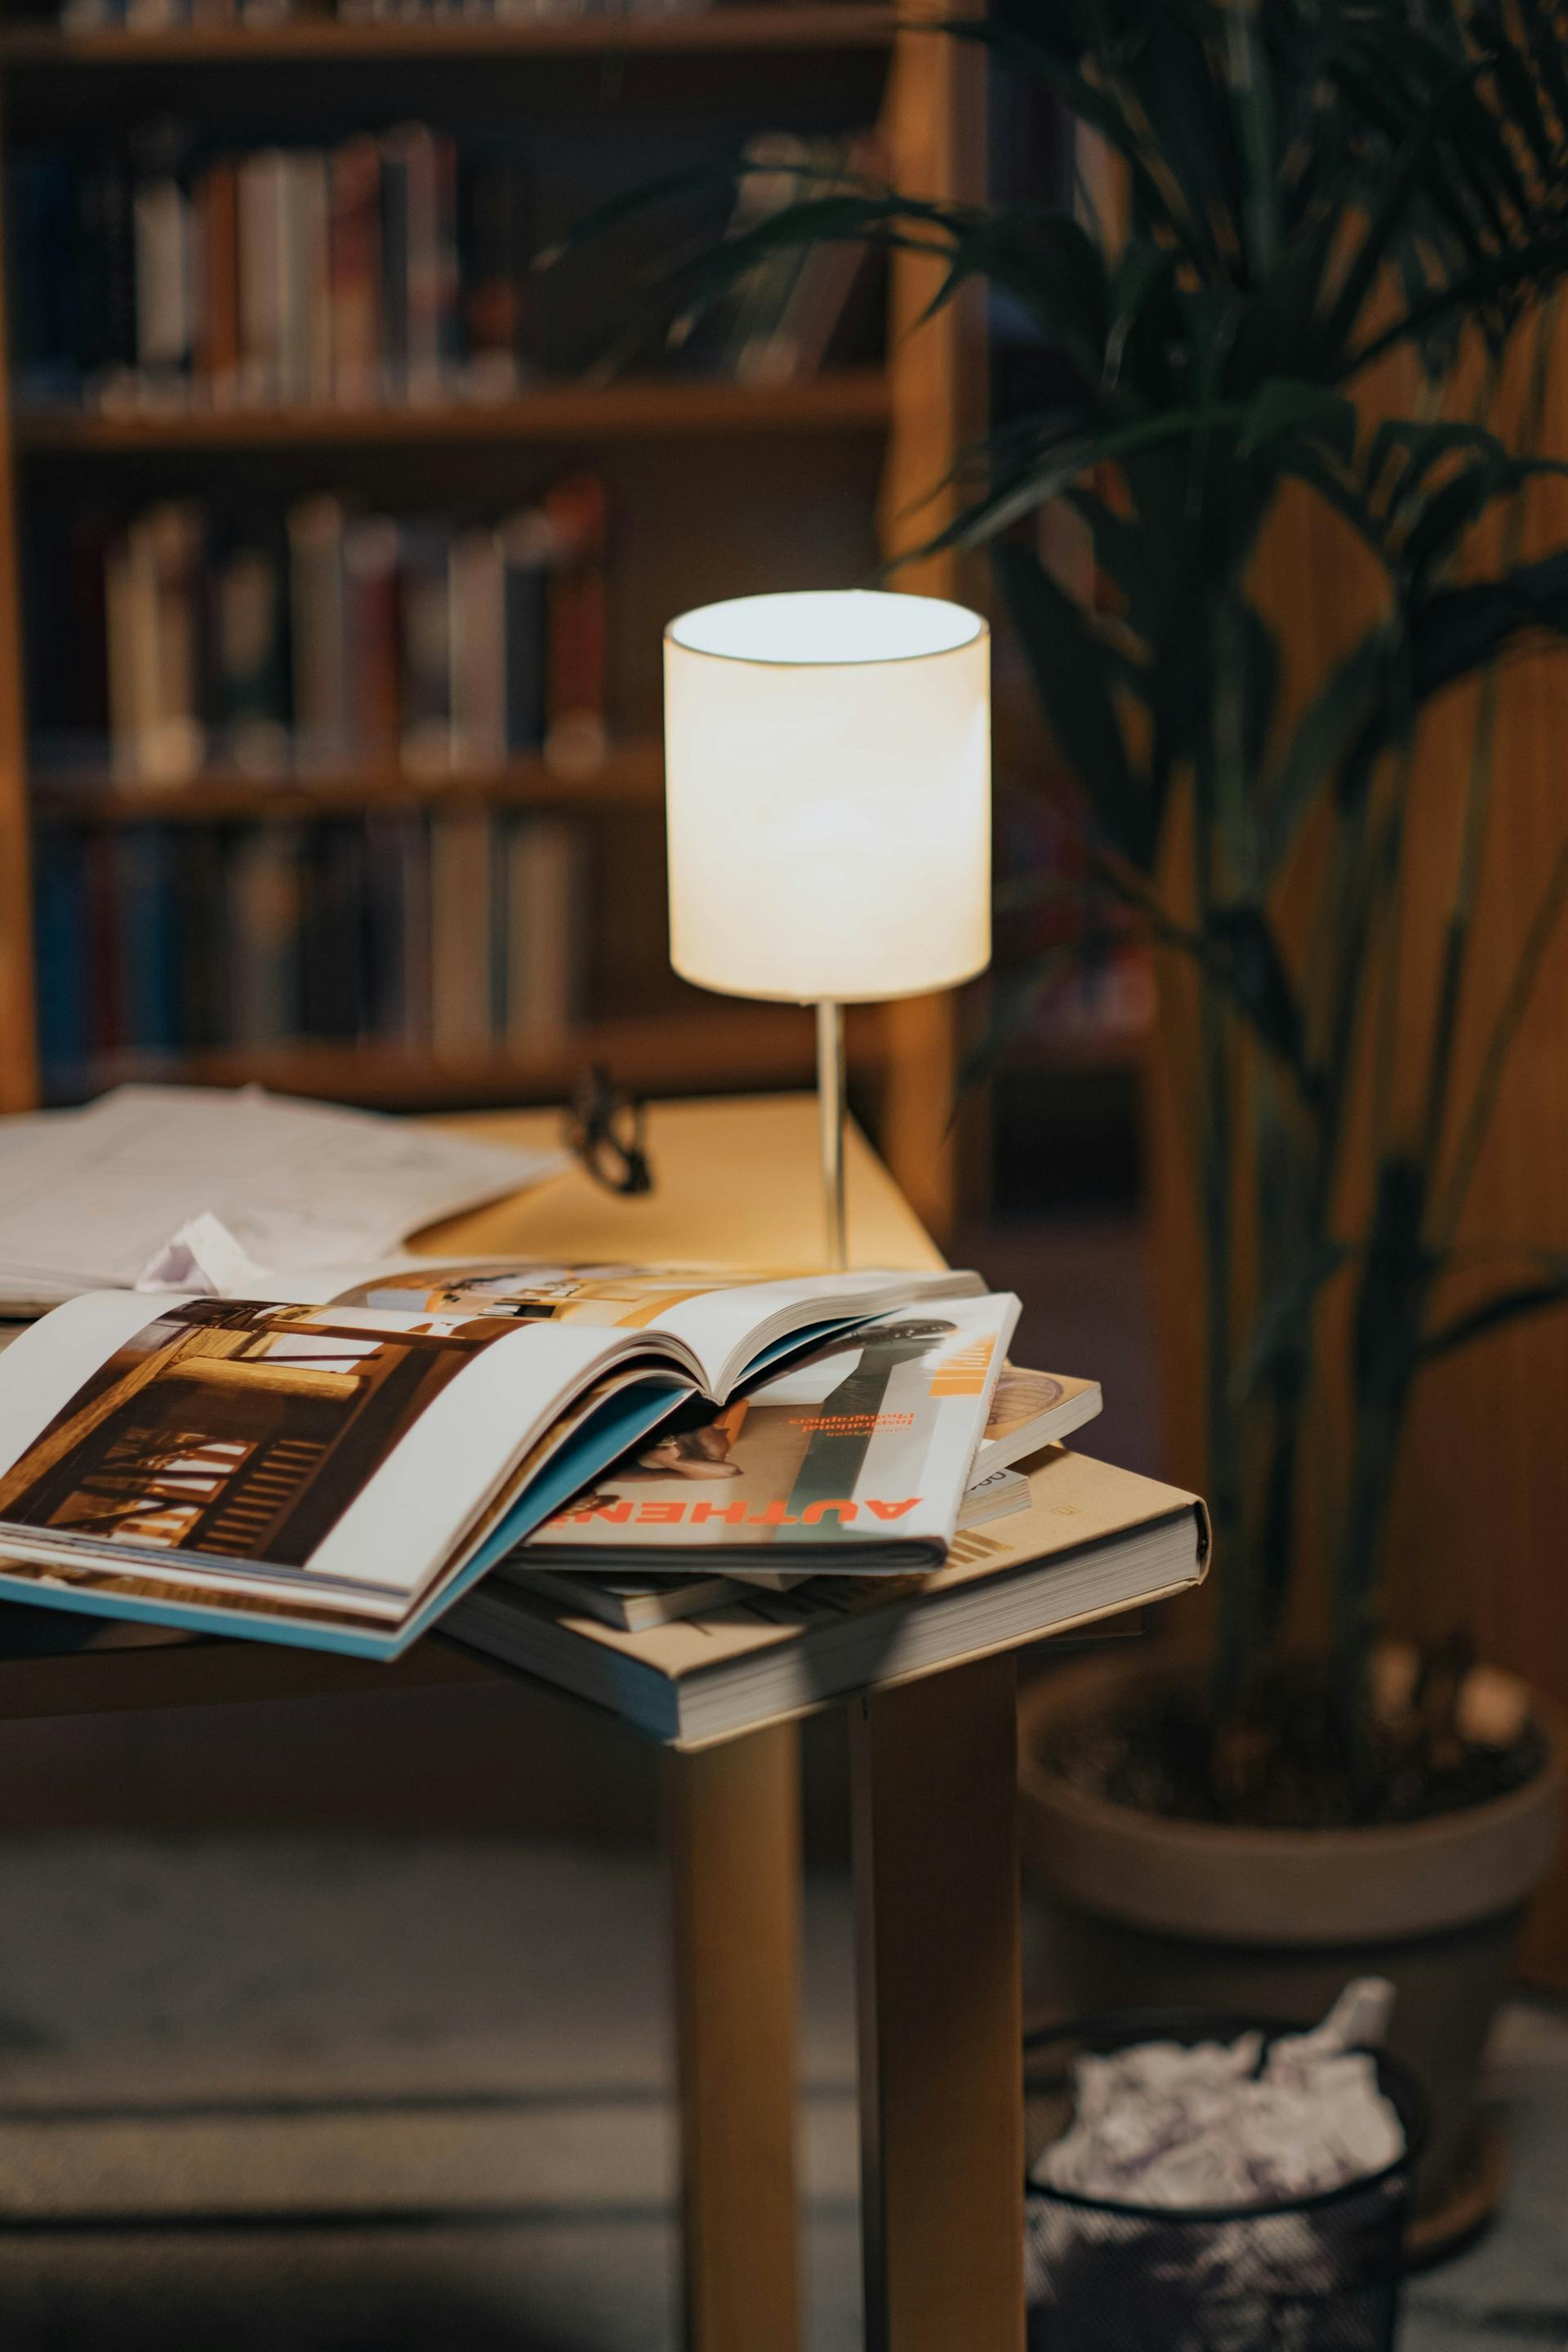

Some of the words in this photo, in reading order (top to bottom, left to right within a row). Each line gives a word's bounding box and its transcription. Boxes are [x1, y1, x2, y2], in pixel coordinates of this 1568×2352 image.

[788, 1413, 914, 1425] Photographers
[802, 1419, 913, 1432] Inspirational
[549, 1498, 924, 1524] AUTHEN
